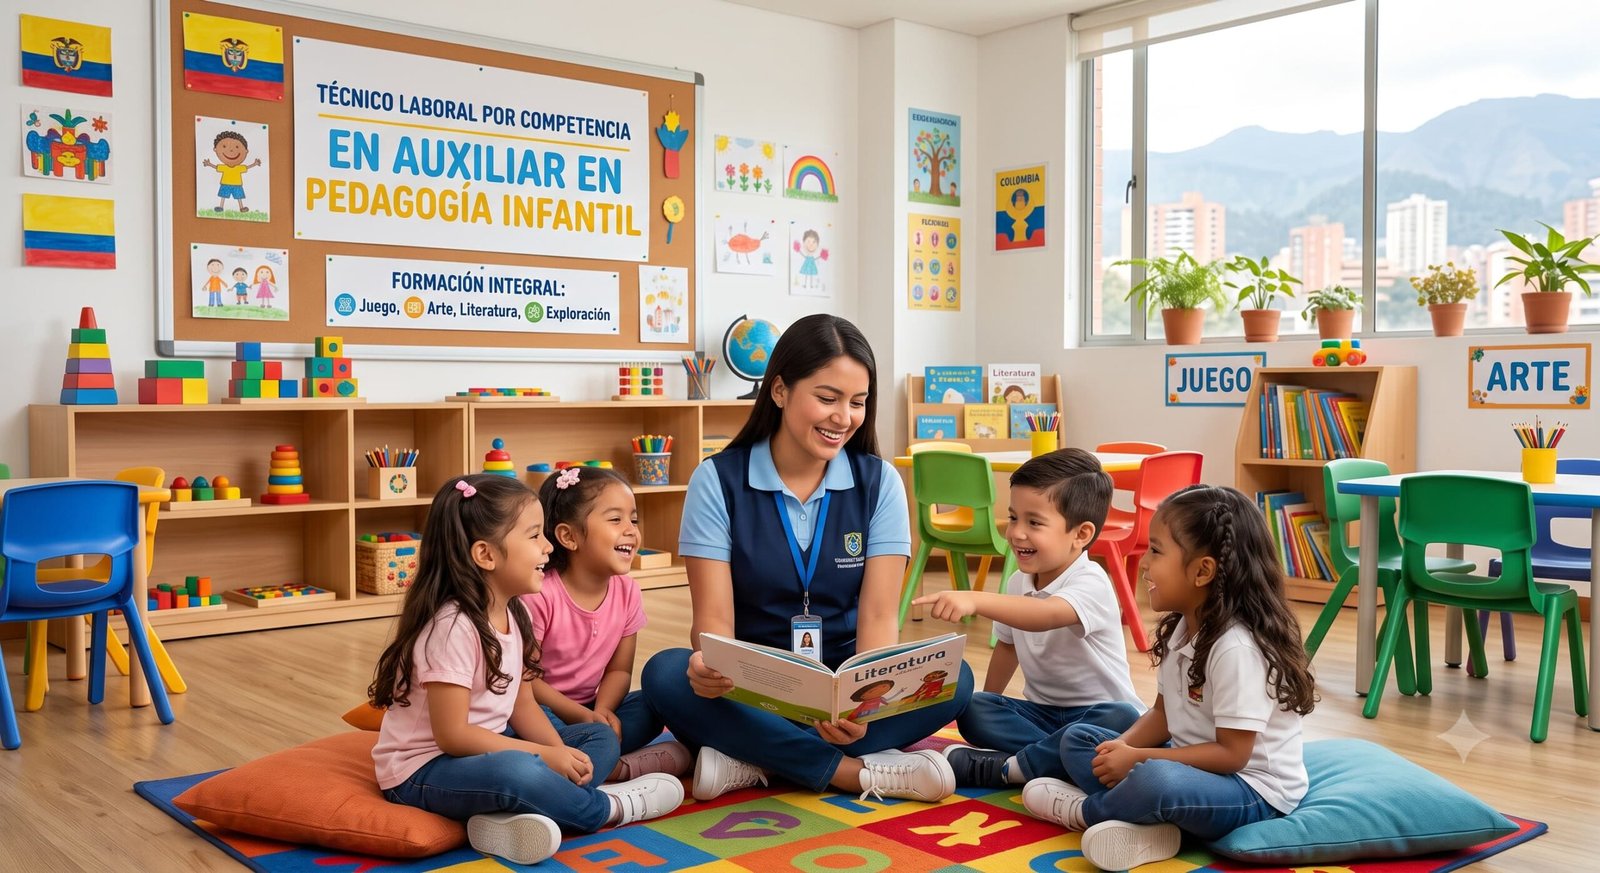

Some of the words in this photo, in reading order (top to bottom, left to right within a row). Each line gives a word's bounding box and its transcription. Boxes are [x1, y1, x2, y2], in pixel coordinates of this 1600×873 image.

[316, 80, 394, 112] TÉCNICO
[399, 94, 478, 123] LABORAL
[482, 105, 516, 128] POR
[520, 110, 632, 142] COMPETENCIA
[329, 129, 380, 172] EN
[392, 135, 566, 189] AUXILIAR
[578, 155, 622, 195] EN
[306, 178, 493, 225] PEDAGOGÍA
[503, 195, 642, 237] INFANTIL
[391, 271, 484, 294] FORMACIÓN
[488, 276, 567, 297] INTEGRAL:
[358, 297, 401, 316] Juego,
[426, 301, 457, 318] Arte,
[459, 302, 521, 321] Literatura,
[546, 305, 612, 324] Exploración
[993, 369, 1036, 377] Literatura
[1176, 366, 1252, 393] JUEGO
[1486, 360, 1572, 392] ARTE
[854, 650, 946, 683] Literatura
